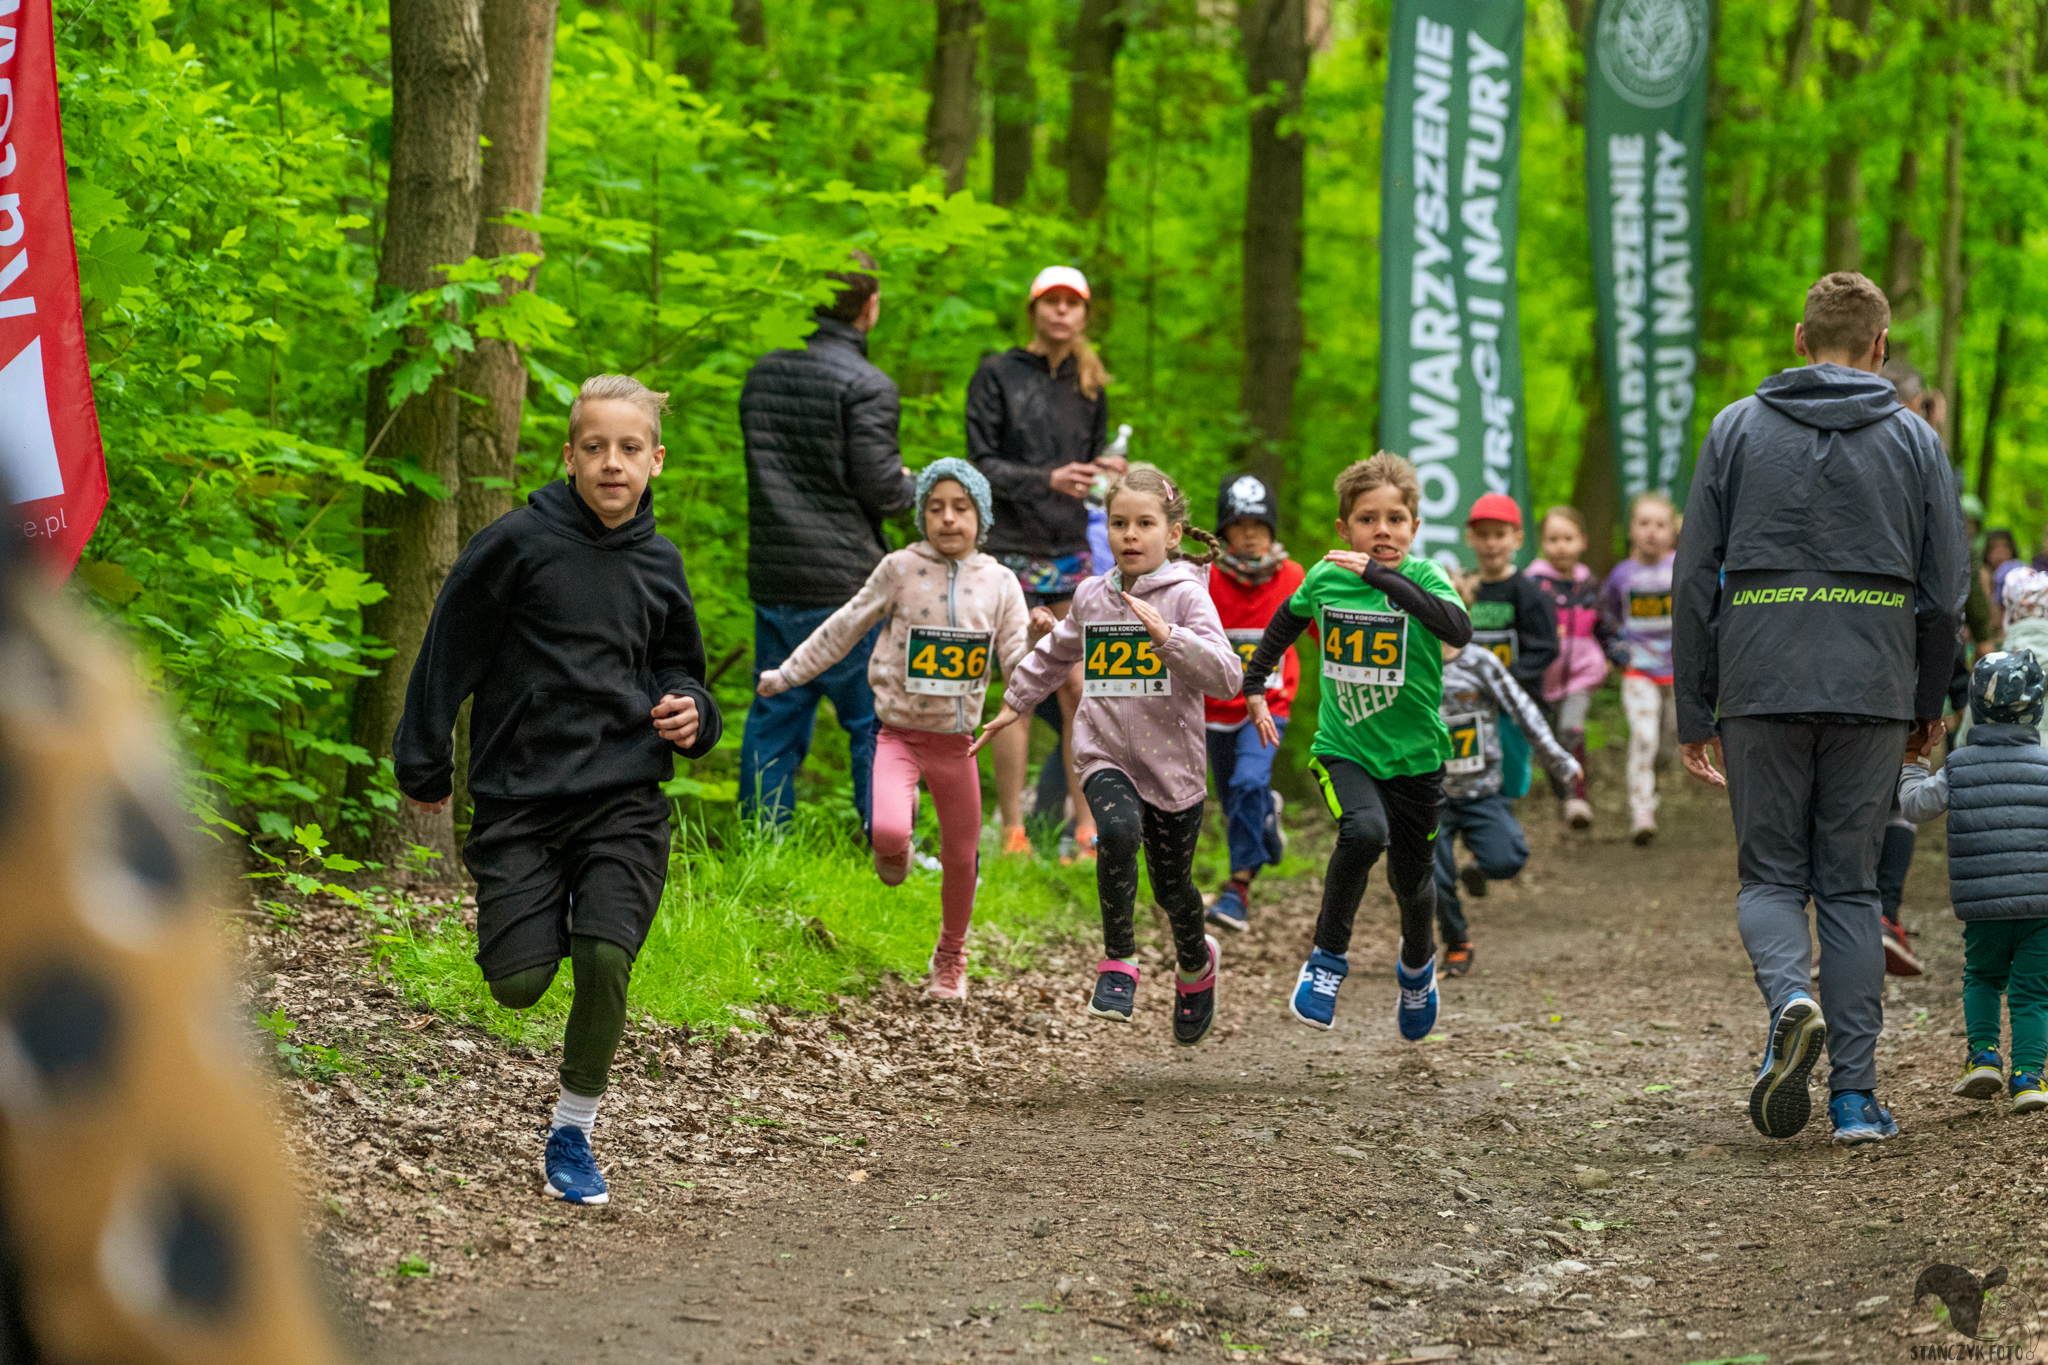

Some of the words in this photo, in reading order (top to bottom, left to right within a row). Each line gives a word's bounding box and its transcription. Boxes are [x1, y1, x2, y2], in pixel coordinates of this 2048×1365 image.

[1461, 28, 1511, 284] NATURY
[1652, 130, 1694, 336] NATURY
[1408, 15, 1462, 574] TOWARZYSZENIE
[14, 507, 67, 539] e.pl
[1732, 587, 1808, 605] UNDER
[1809, 587, 1905, 608] ARMOUR
[911, 644, 987, 678] 436
[1088, 641, 1162, 676] 425
[1326, 627, 1398, 665] 415
[1338, 684, 1399, 727] SLEEP
